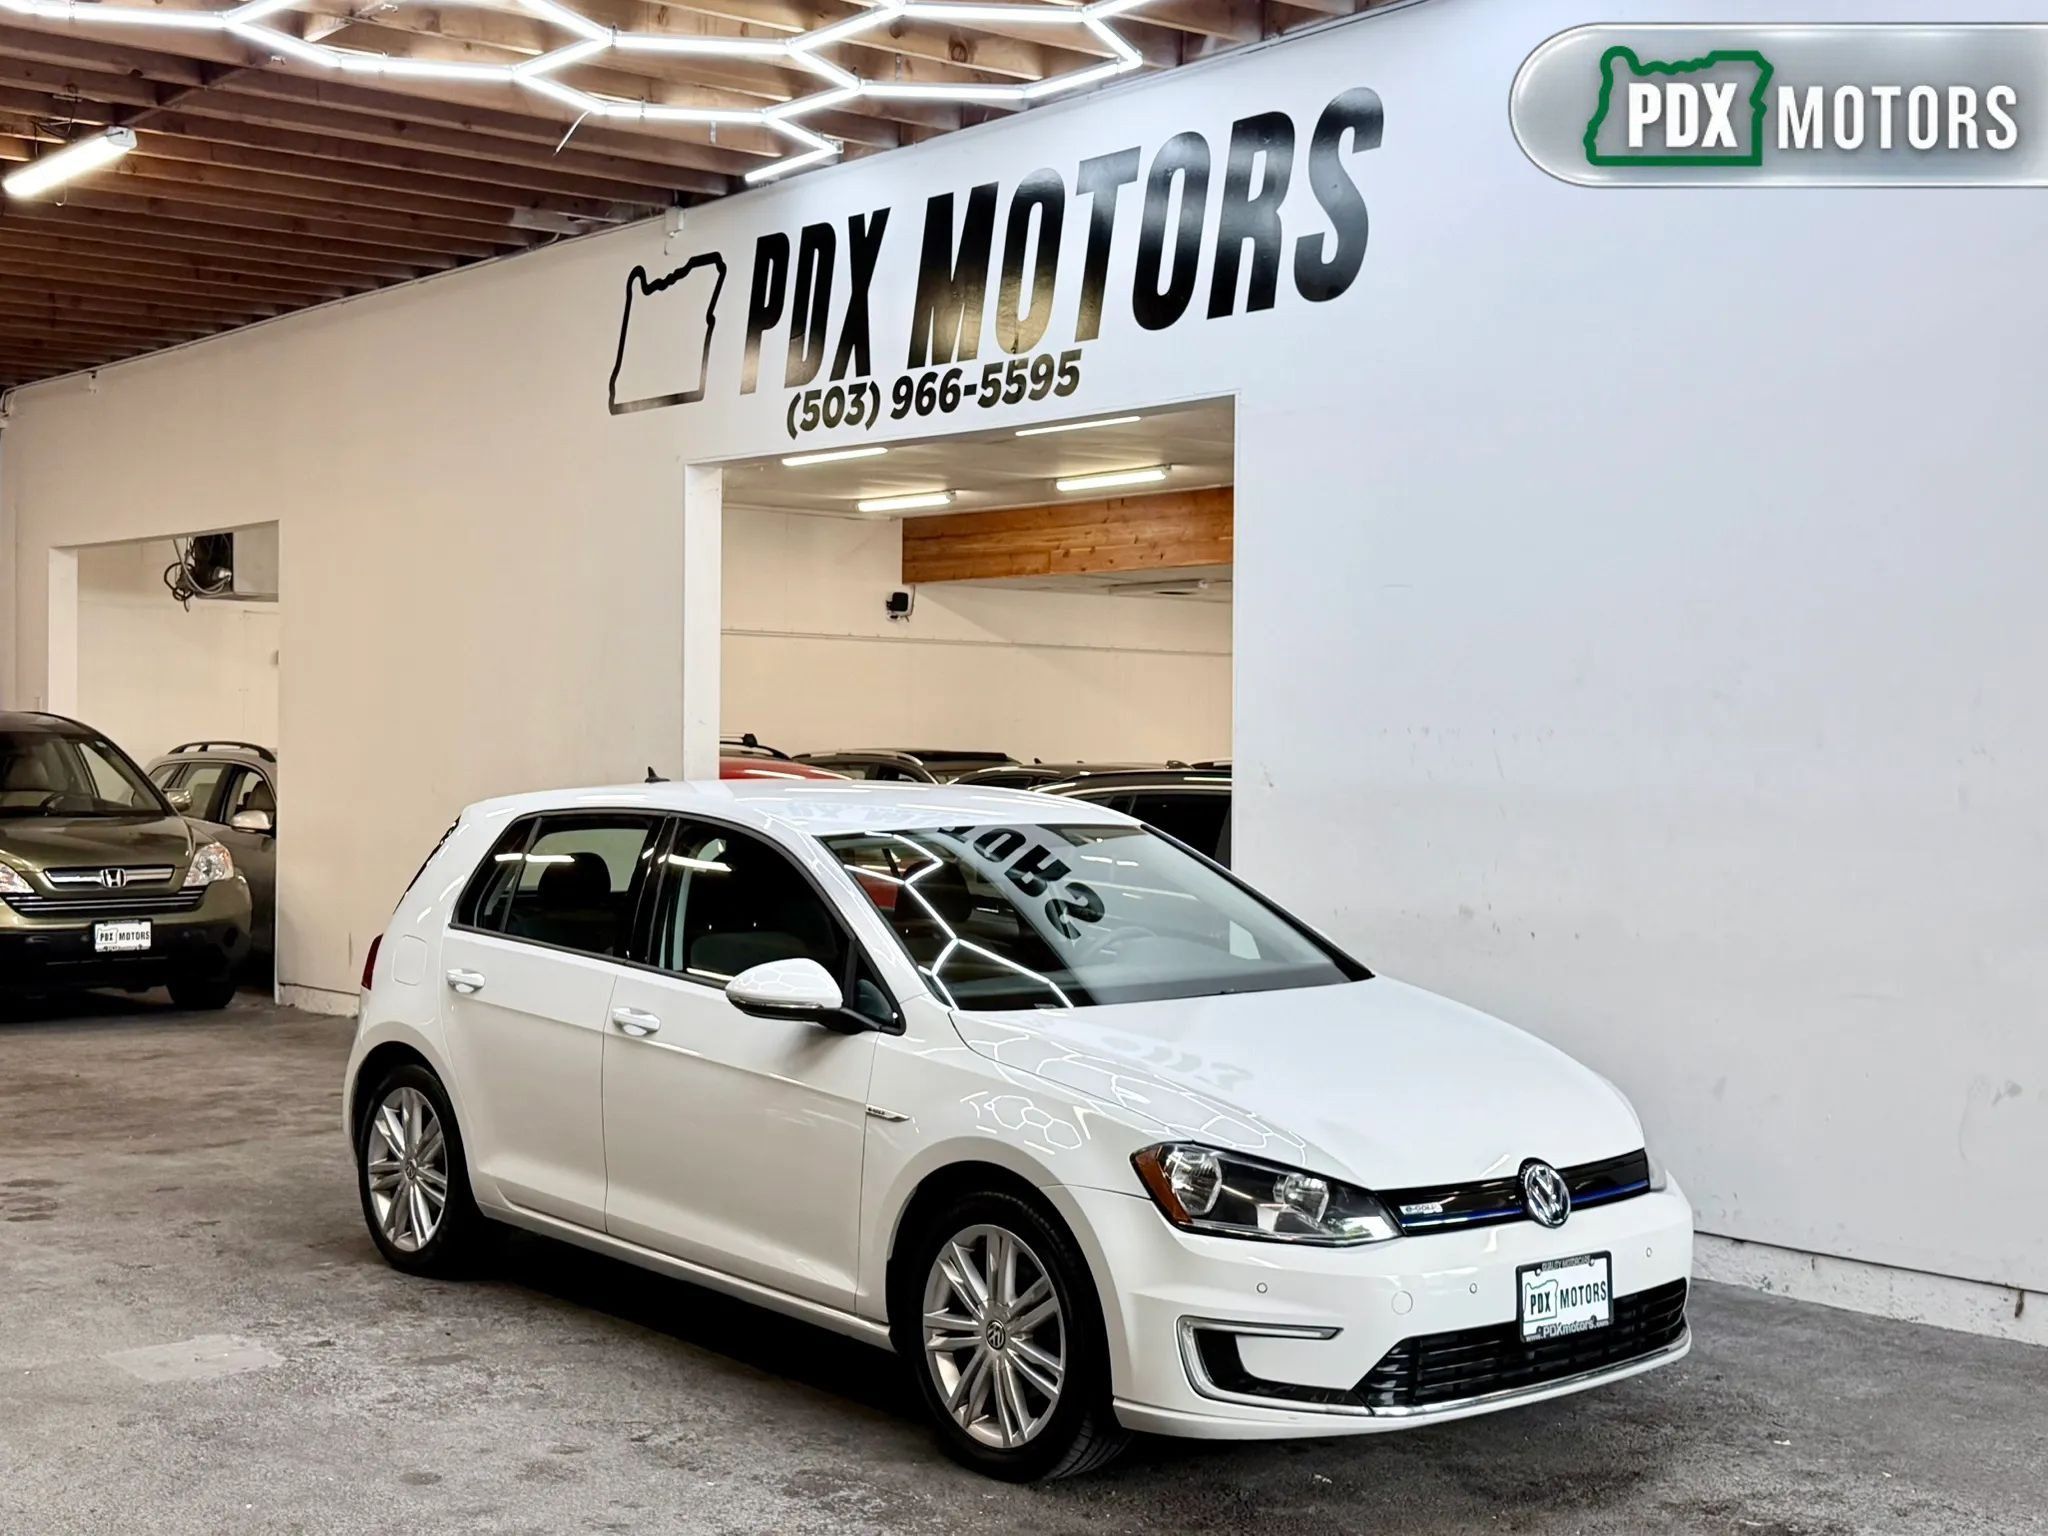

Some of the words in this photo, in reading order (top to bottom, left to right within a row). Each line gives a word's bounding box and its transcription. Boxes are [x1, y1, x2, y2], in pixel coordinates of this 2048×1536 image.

[740, 206, 891, 395] PDX
[906, 86, 1384, 370] MOTORS
[787, 380, 881, 440] (503)
[890, 349, 1082, 420] 966-5595
[100, 932, 114, 942] PDX
[119, 931, 150, 941] MOTORS
[1530, 1291, 1551, 1315] PDX
[1560, 1281, 1607, 1309] MOTORS
